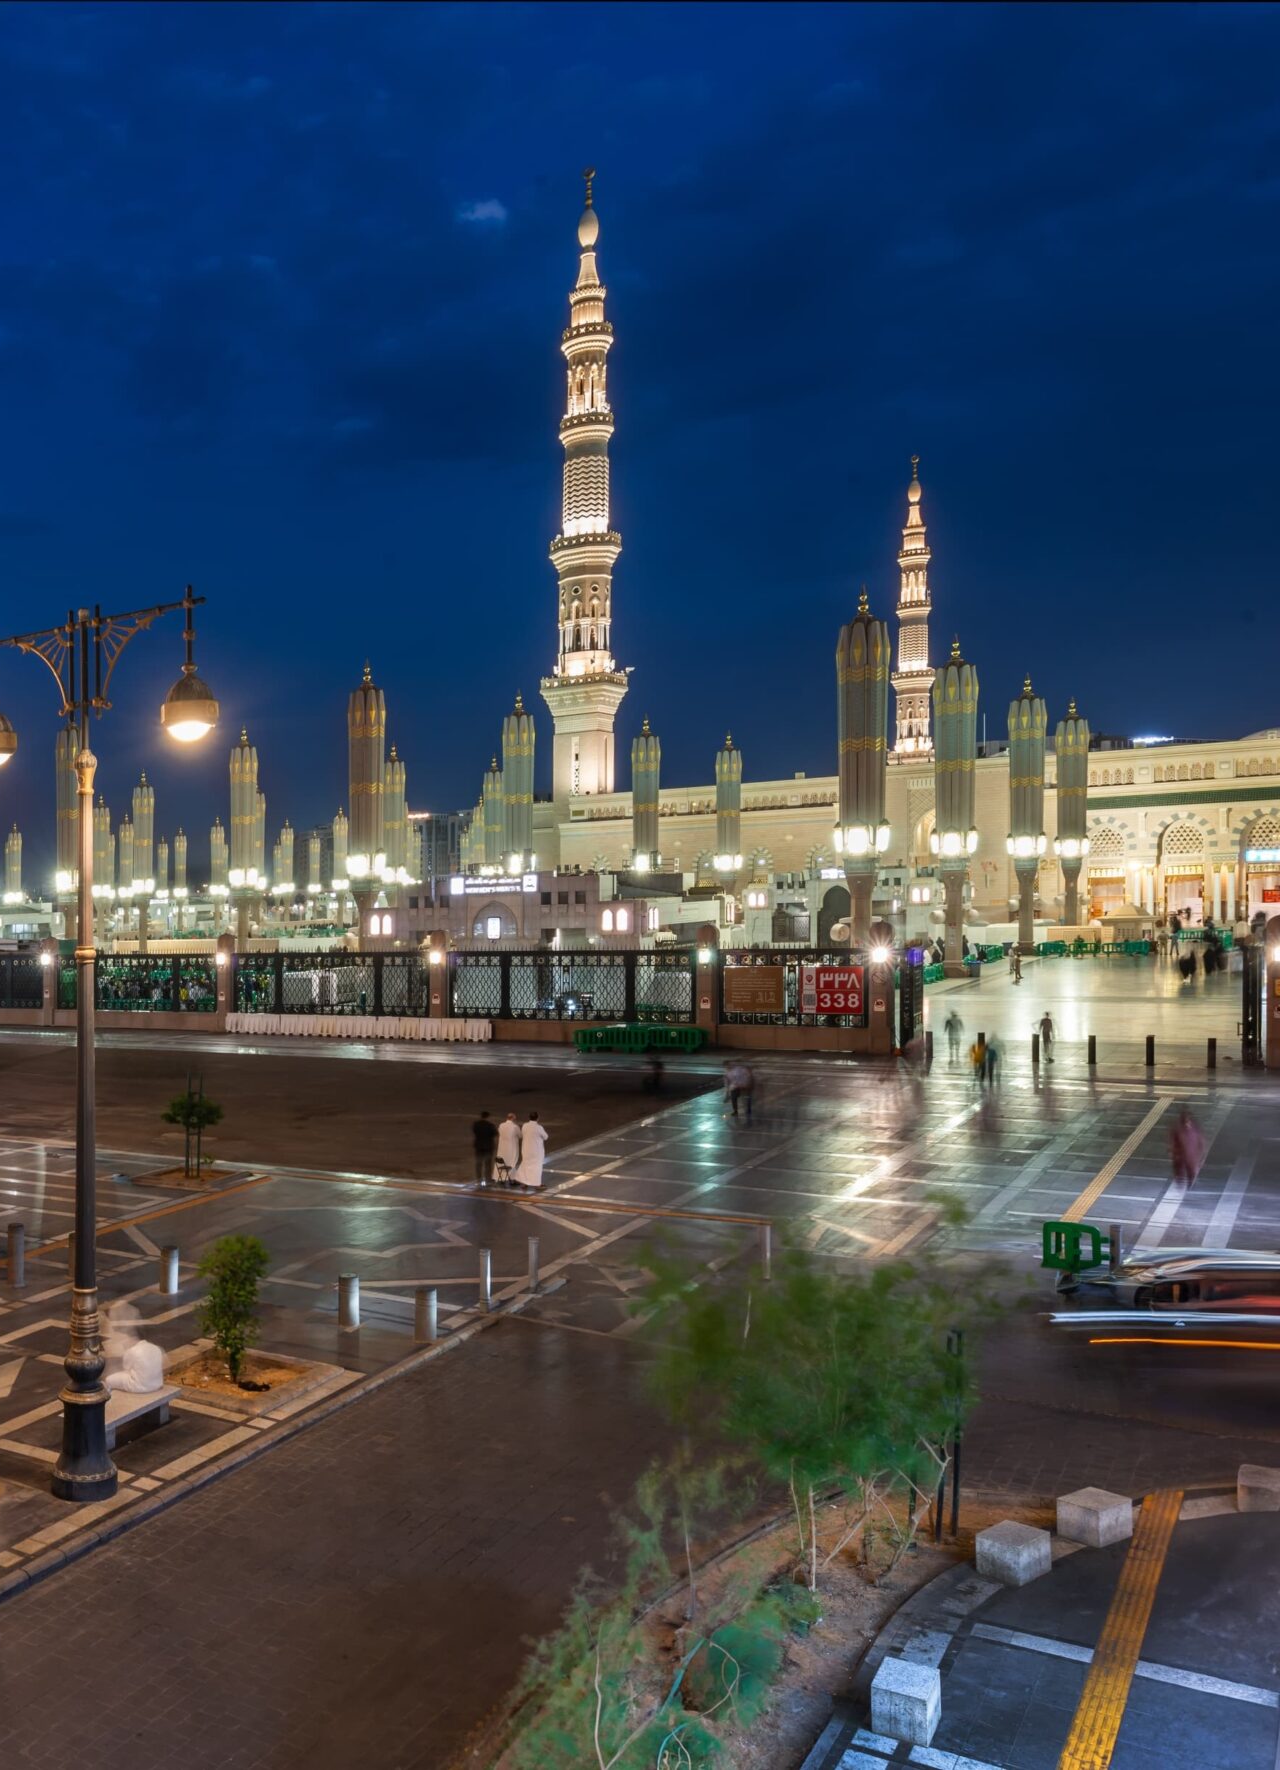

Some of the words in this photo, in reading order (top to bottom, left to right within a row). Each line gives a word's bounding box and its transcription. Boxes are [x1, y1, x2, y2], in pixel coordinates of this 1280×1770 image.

[1040, 859, 1058, 871] 25
[819, 972, 860, 989] ٣٣٨
[819, 993, 860, 1008] 338
